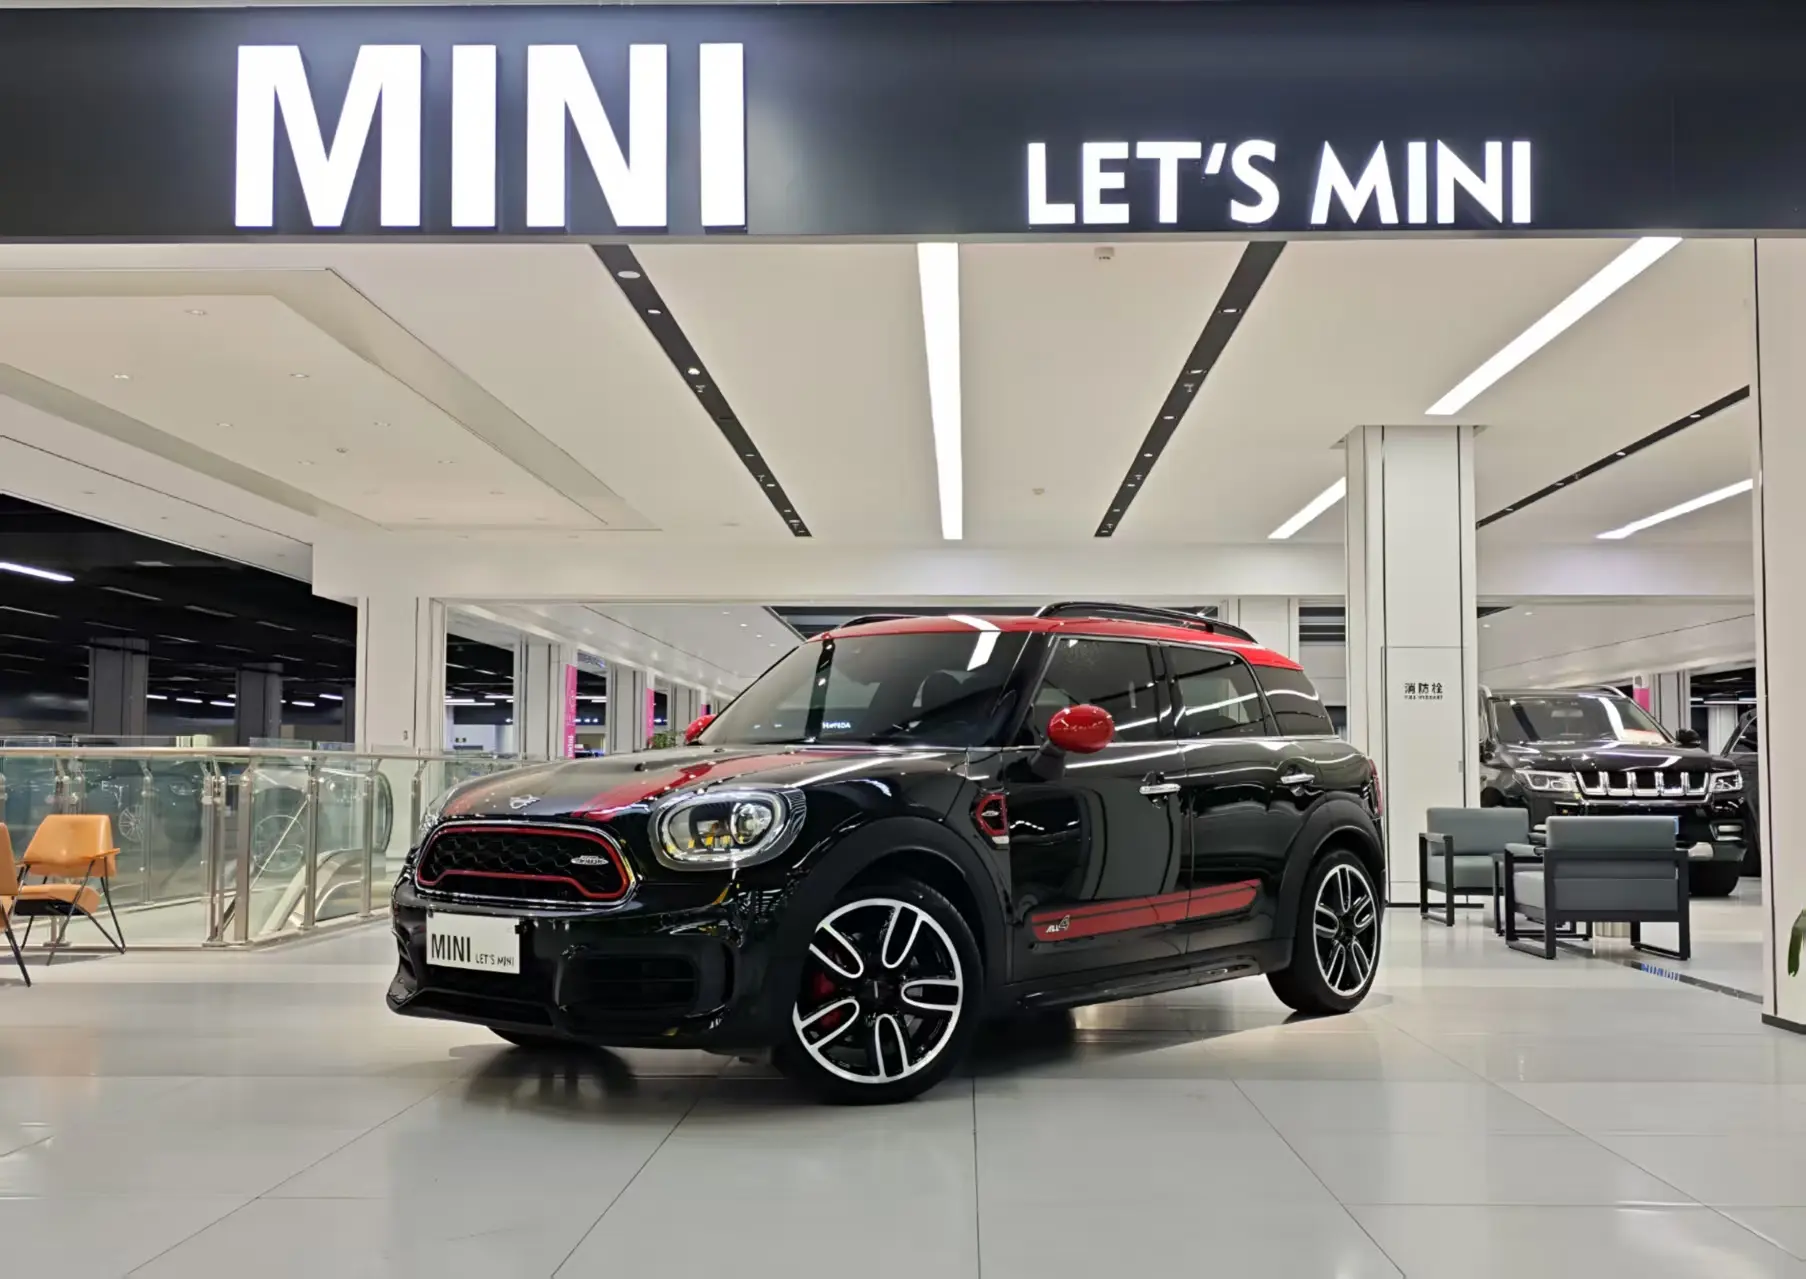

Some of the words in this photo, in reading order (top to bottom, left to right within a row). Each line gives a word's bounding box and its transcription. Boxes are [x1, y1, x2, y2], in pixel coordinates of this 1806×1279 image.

[235, 43, 746, 227] MINI
[1027, 139, 1280, 225] LET'S
[1310, 139, 1532, 225] MINI
[1404, 682, 1443, 694] 消防栓
[431, 933, 471, 963] MINI
[475, 953, 496, 966] LET'S
[497, 956, 515, 967] MINI
